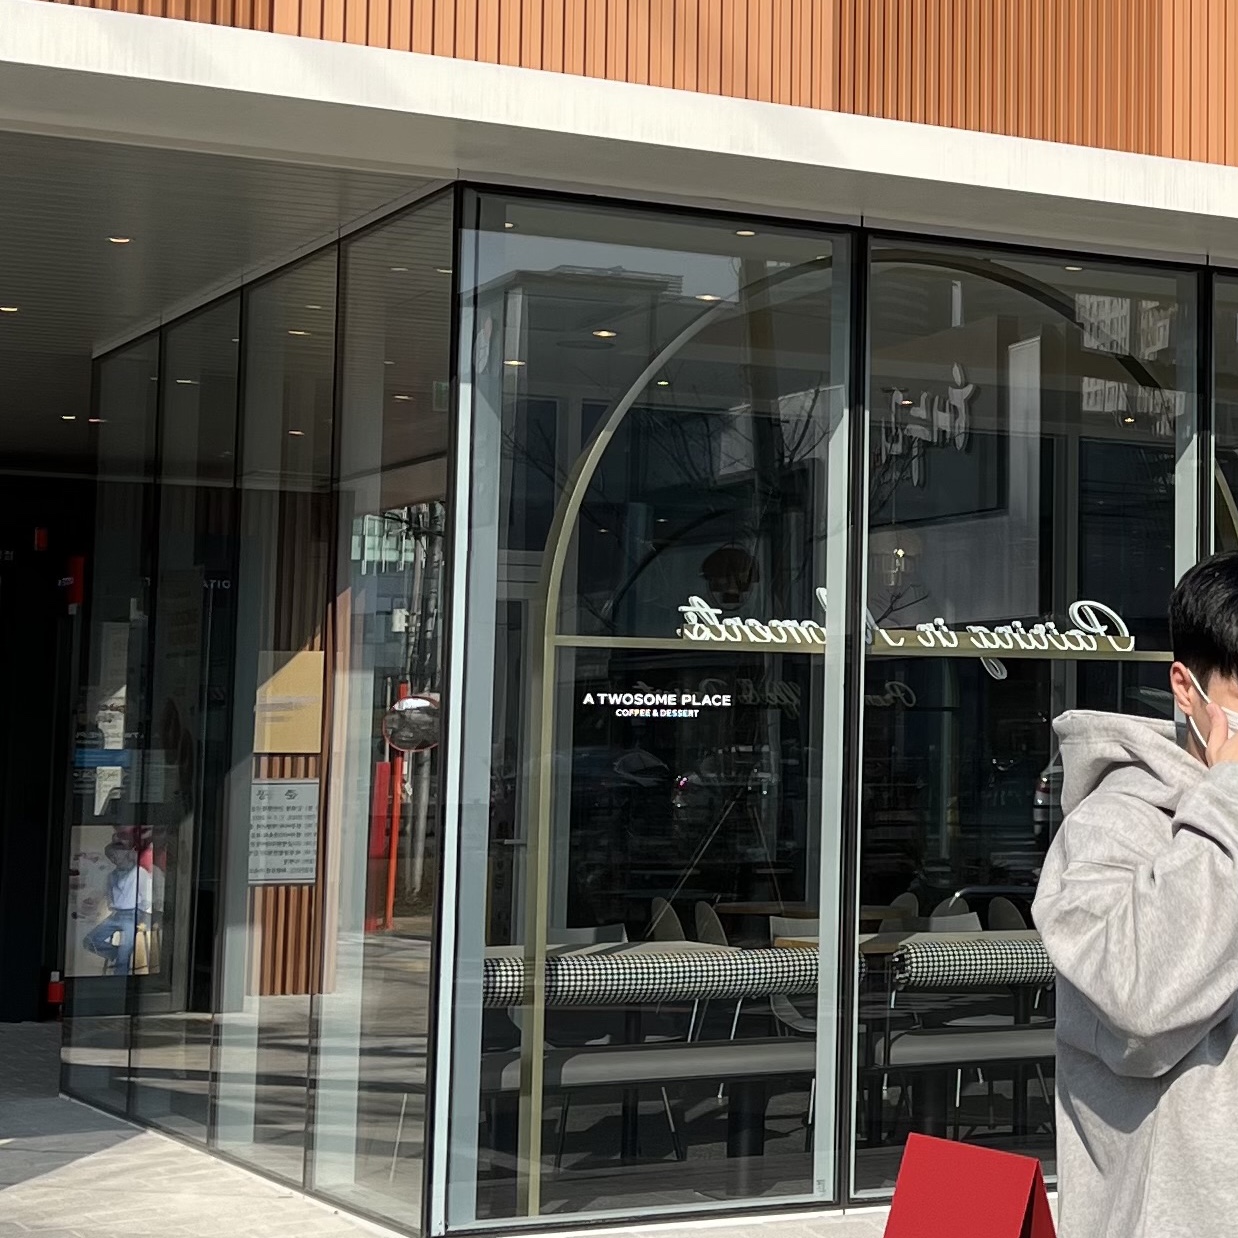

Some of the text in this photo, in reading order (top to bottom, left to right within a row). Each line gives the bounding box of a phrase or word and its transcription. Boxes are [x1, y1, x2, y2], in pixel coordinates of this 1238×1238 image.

[583, 692, 732, 707] A TWOSOME PLACE
[615, 708, 651, 718] COFFEE
[659, 708, 700, 718] DESSERT
